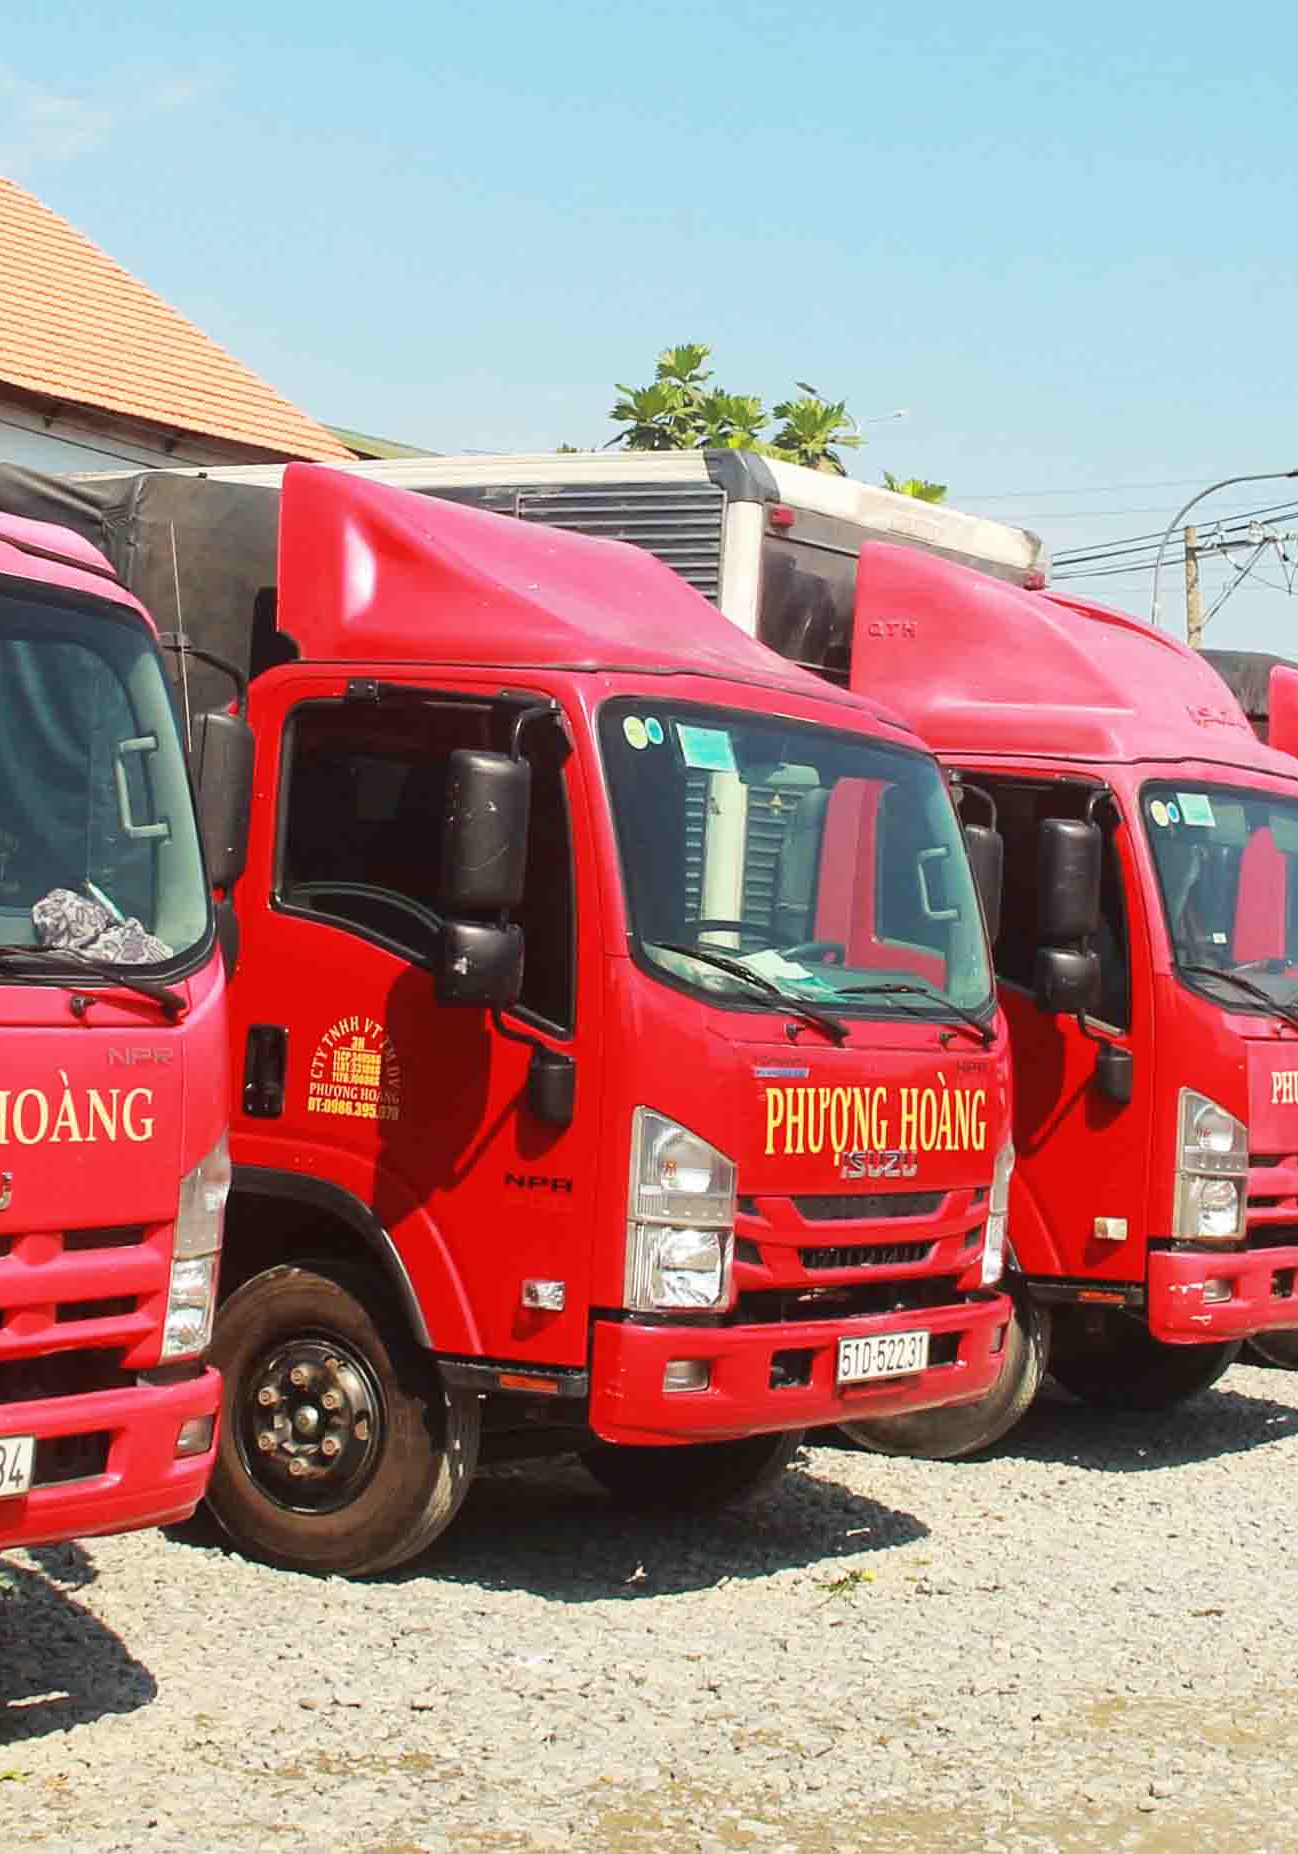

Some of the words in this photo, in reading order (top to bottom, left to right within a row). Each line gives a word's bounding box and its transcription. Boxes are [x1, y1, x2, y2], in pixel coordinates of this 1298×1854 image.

[107, 1046, 174, 1066] NPR
[310, 1046, 328, 1079] CTY
[322, 1015, 359, 1048] TNHH
[364, 1017, 383, 1039] VT
[764, 1087, 889, 1167] PHƯỢNG
[899, 1072, 987, 1151] HOÀNG
[840, 1150, 917, 1179] ISUZU
